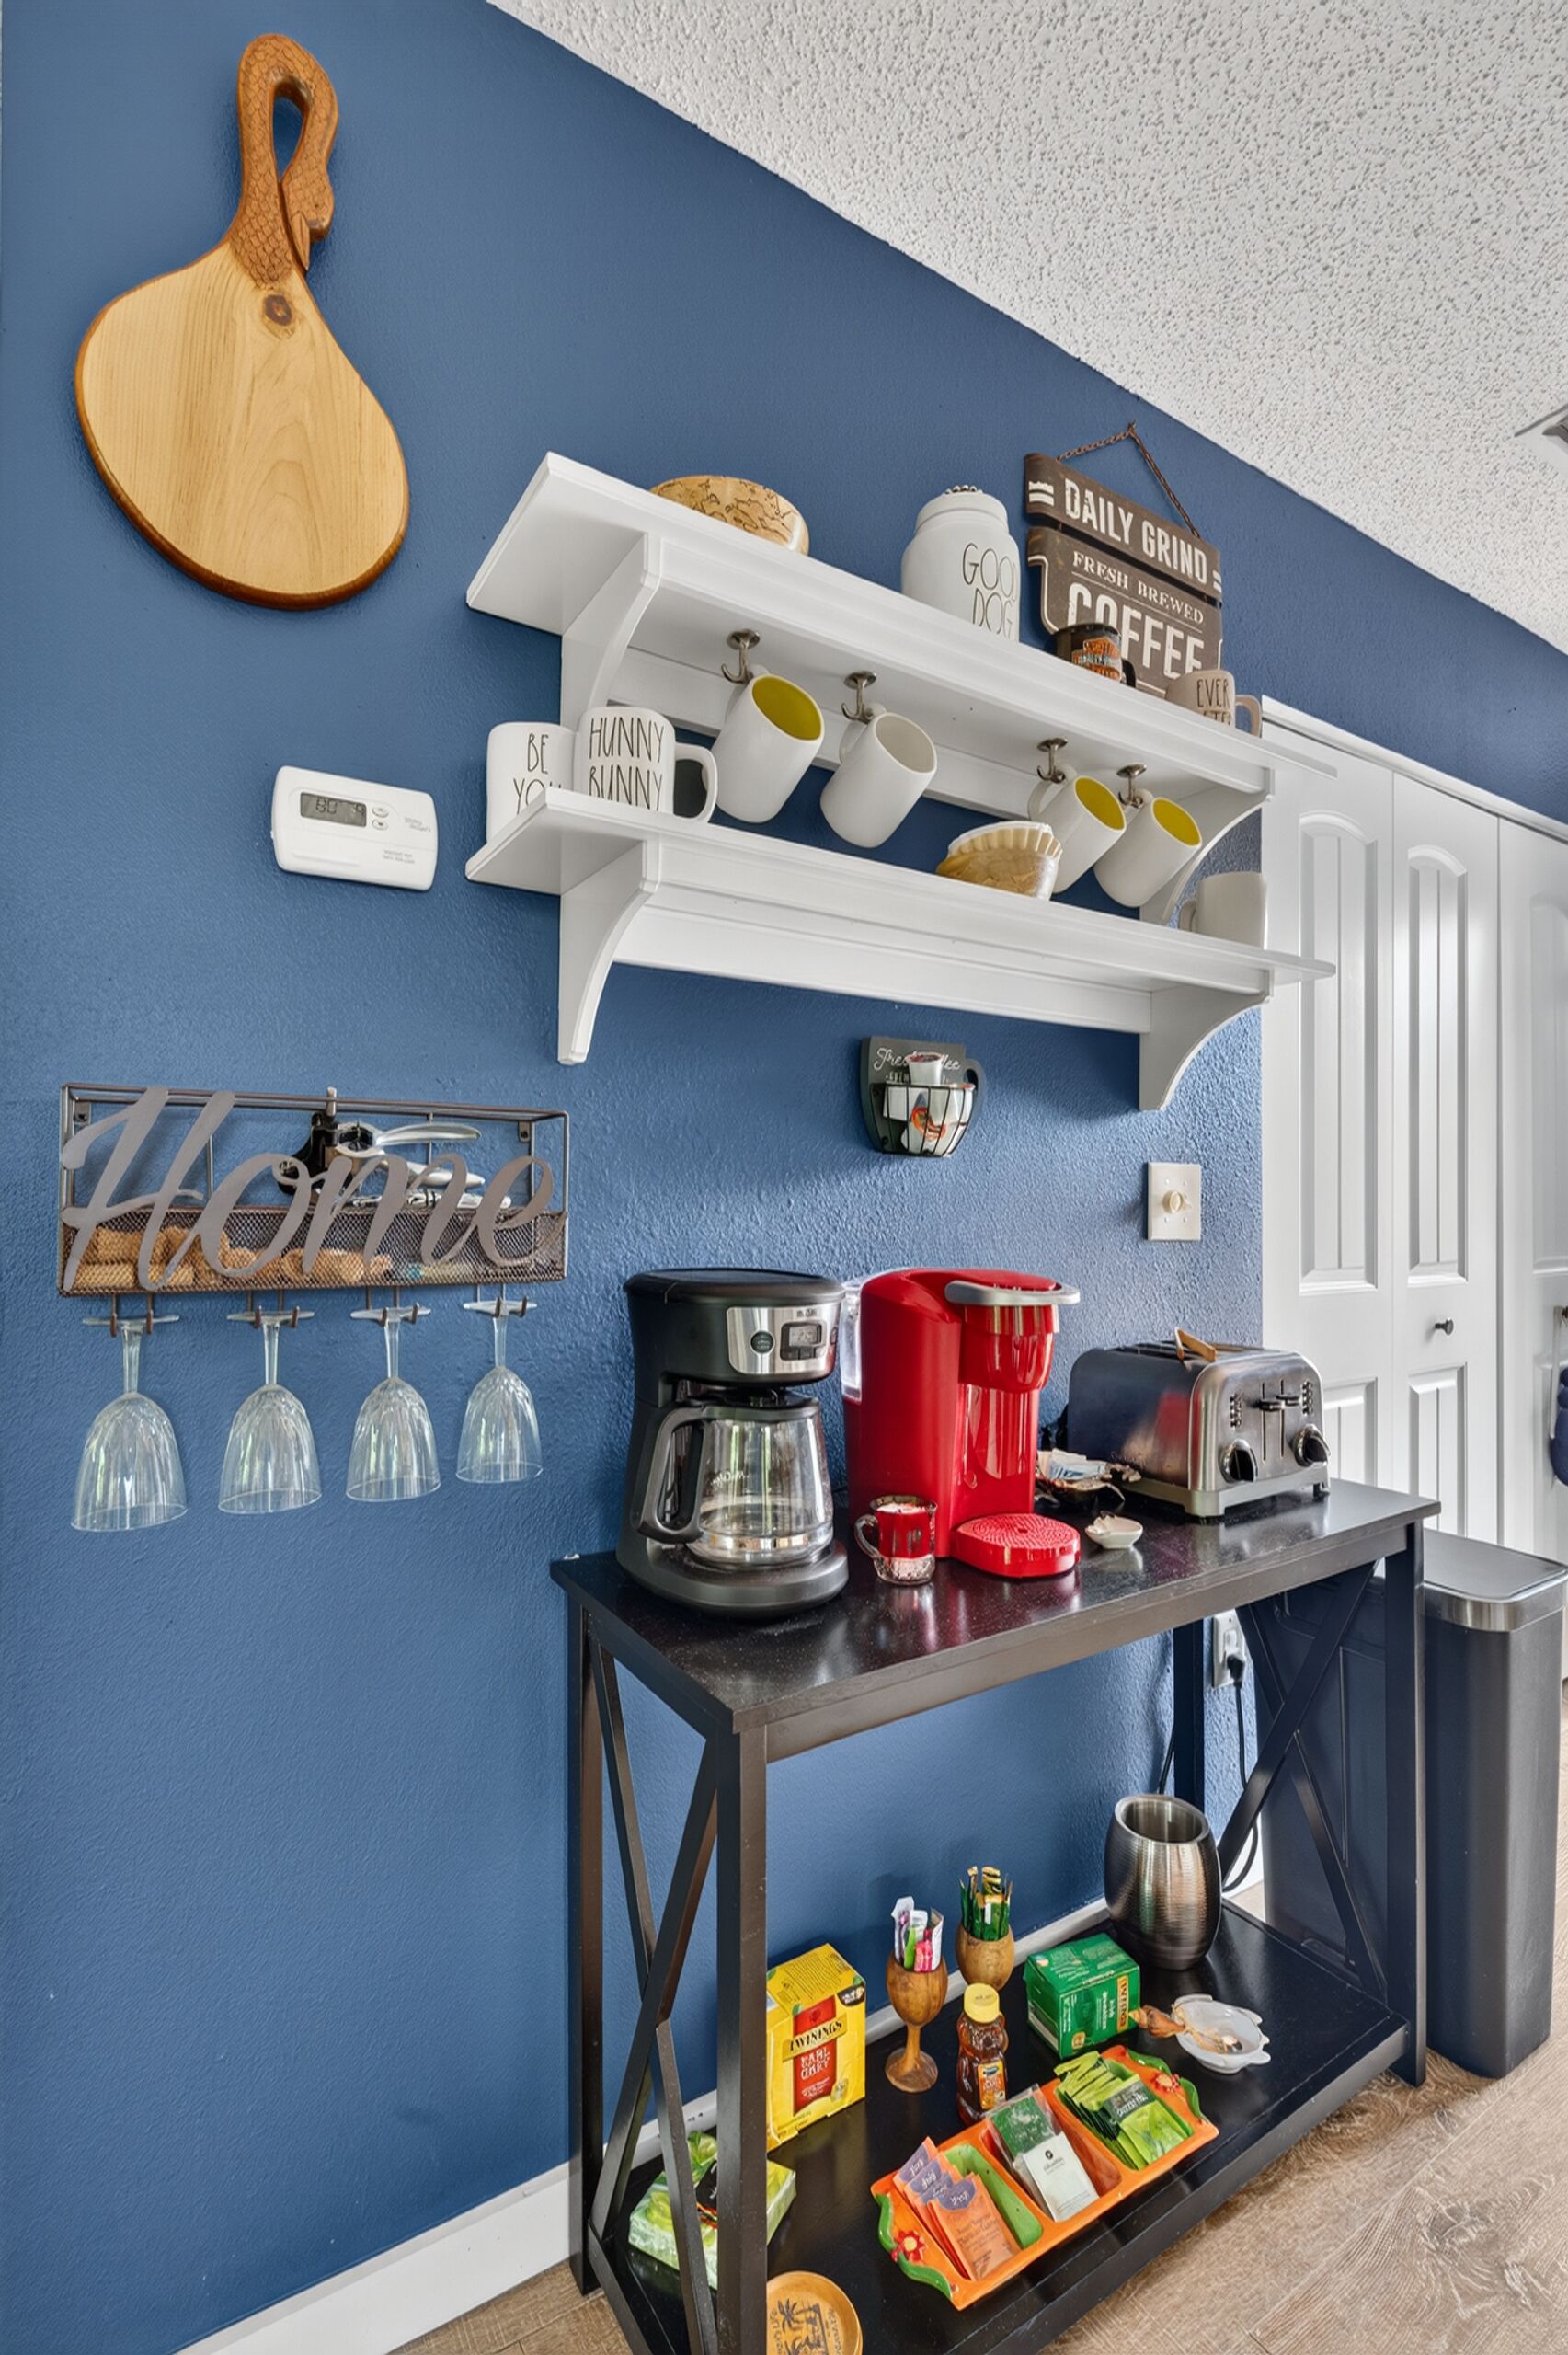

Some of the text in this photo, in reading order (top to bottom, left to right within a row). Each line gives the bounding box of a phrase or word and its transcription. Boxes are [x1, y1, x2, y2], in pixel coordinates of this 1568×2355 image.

[1064, 477, 1207, 585] DAILY GRIND
[1072, 550, 1204, 625] FRESH BREWED
[972, 587, 1013, 639] DOG
[1067, 581, 1206, 681] COFFEE
[1196, 678, 1230, 709] EVER
[527, 732, 550, 775] BE
[589, 716, 665, 764] HUNNY
[512, 777, 562, 815] YO
[589, 764, 663, 812] BUNNY
[61, 1086, 567, 1292] Home
[789, 2020, 843, 2052] TWININGS
